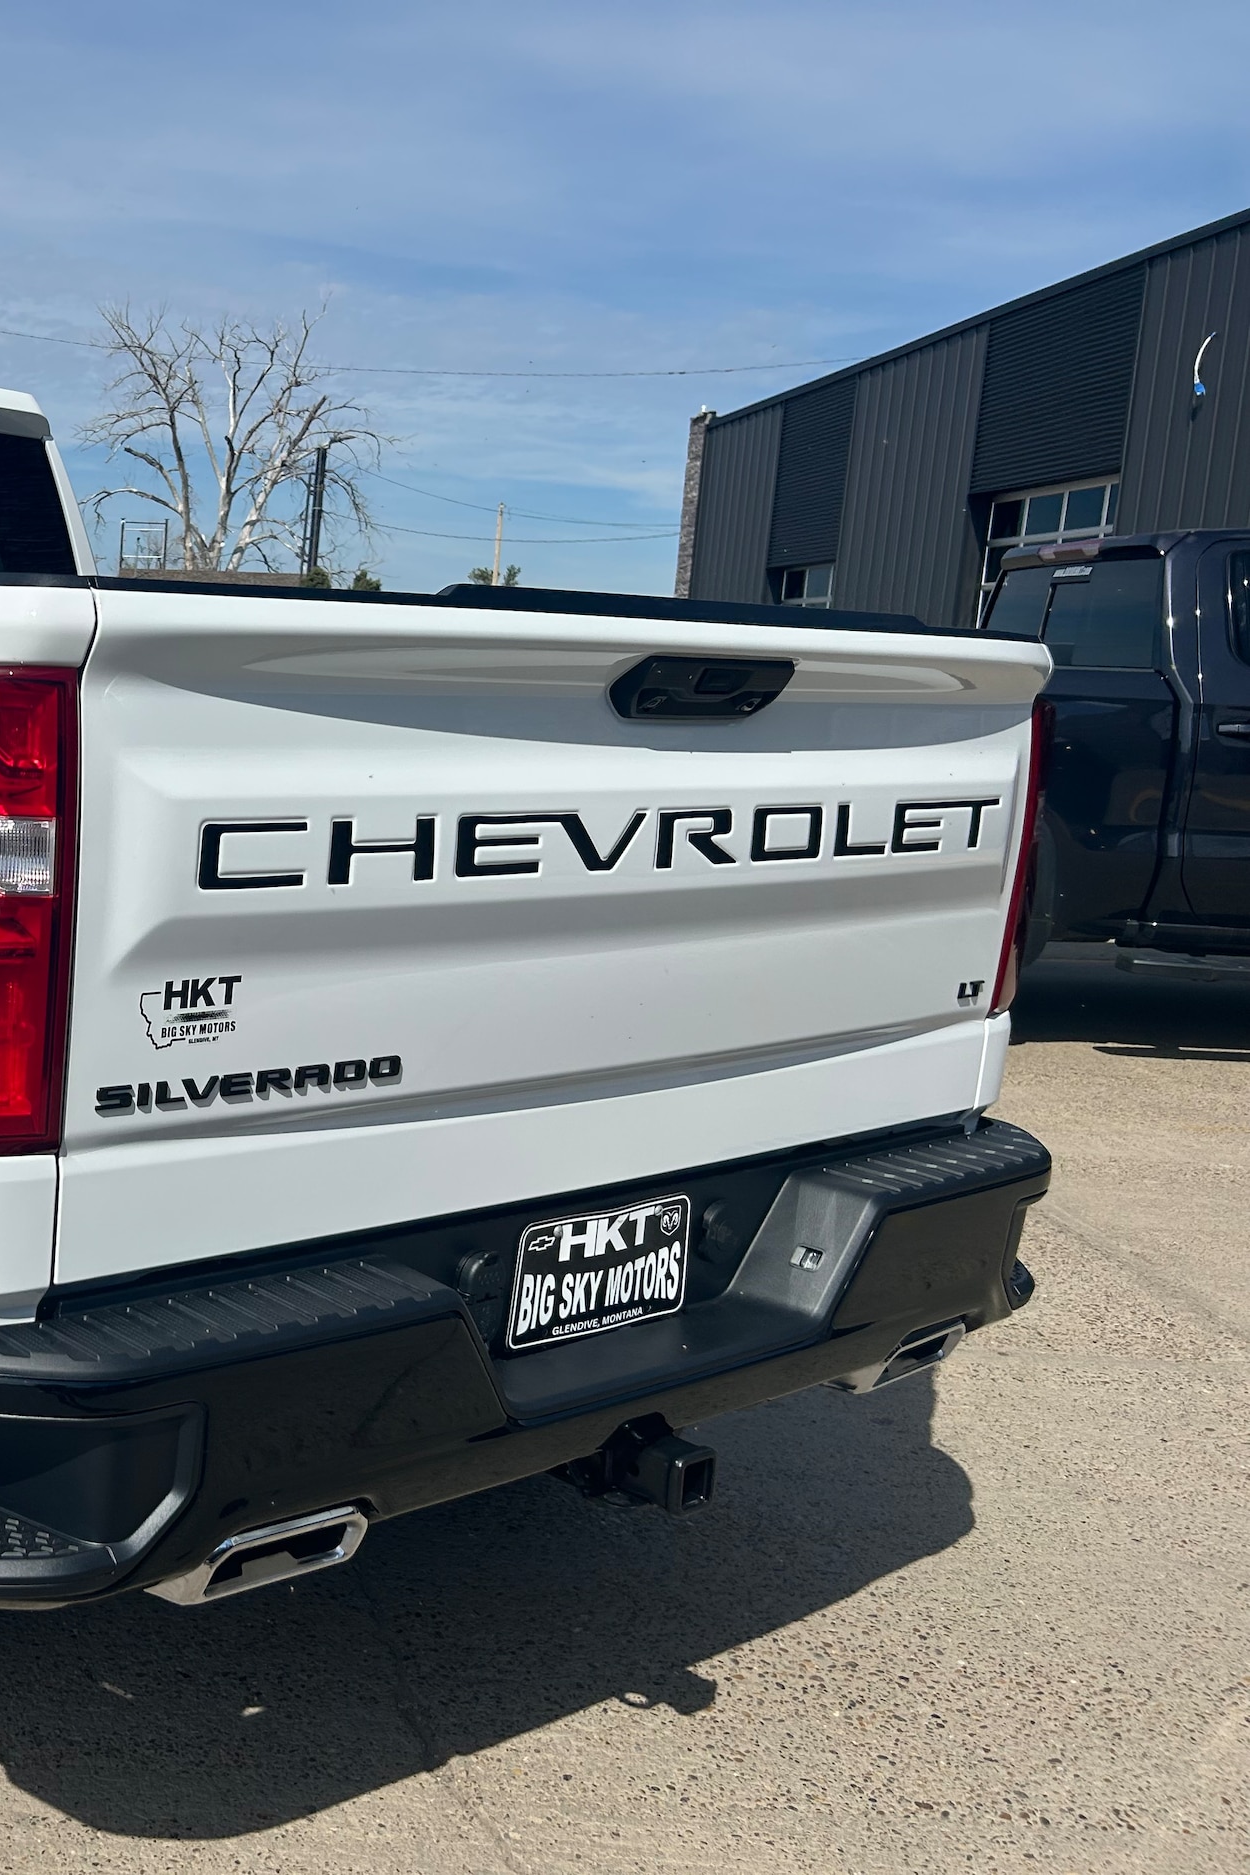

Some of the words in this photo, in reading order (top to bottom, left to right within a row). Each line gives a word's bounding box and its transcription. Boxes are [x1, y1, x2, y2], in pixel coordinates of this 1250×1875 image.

[197, 798, 1002, 891] CHEVROLET
[163, 975, 242, 1011] HKT
[957, 980, 985, 999] LT
[161, 1026, 177, 1039] BIG
[179, 1024, 197, 1037] SKY
[199, 1021, 236, 1035] MOTORS
[95, 1055, 403, 1113] SILVERADO
[558, 1205, 657, 1262] HKT
[516, 1273, 555, 1336] BIG
[558, 1270, 604, 1320] SKY
[604, 1241, 681, 1308] MOTORS
[552, 1317, 600, 1336] GLENDIVE,
[602, 1306, 643, 1325] MONTANA
